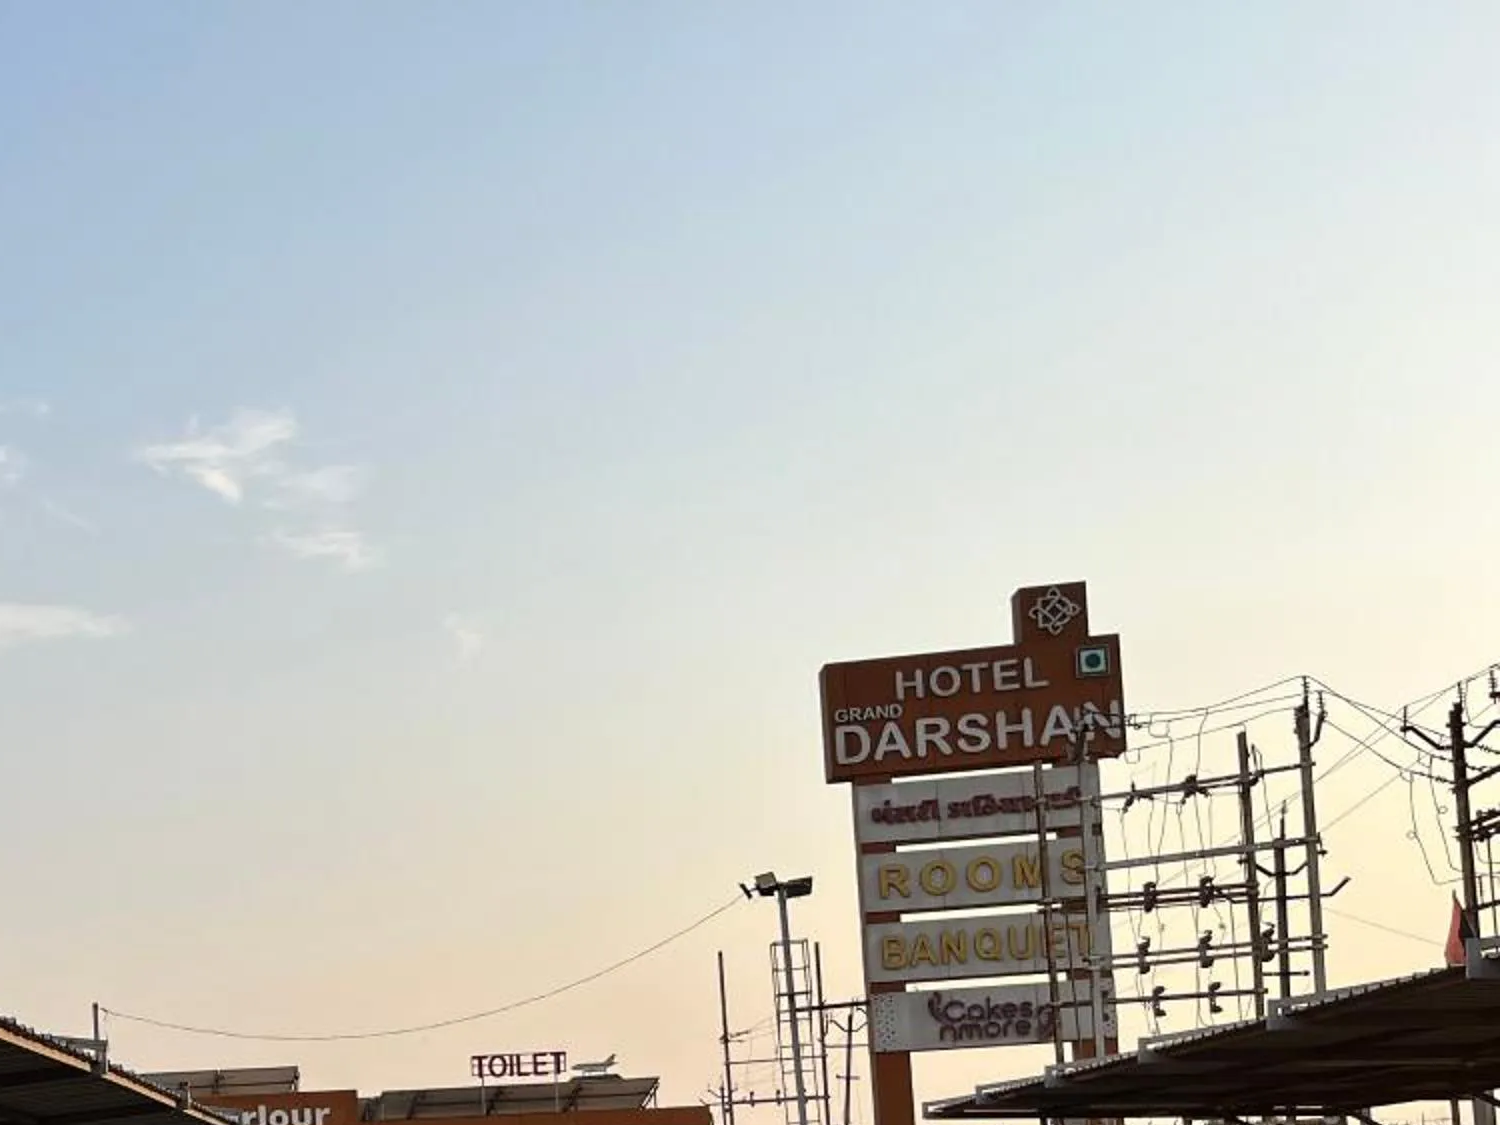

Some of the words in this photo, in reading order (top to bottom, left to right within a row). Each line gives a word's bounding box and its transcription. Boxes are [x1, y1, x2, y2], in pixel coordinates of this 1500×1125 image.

[896, 656, 1050, 700] HOTEL
[834, 703, 903, 723] GRAND
[835, 699, 1122, 765] DARSHAN
[878, 848, 1086, 899] ROOMS
[881, 923, 1094, 971] BANQUET
[943, 995, 1033, 1022] Cakes
[472, 1051, 566, 1078] TOILET
